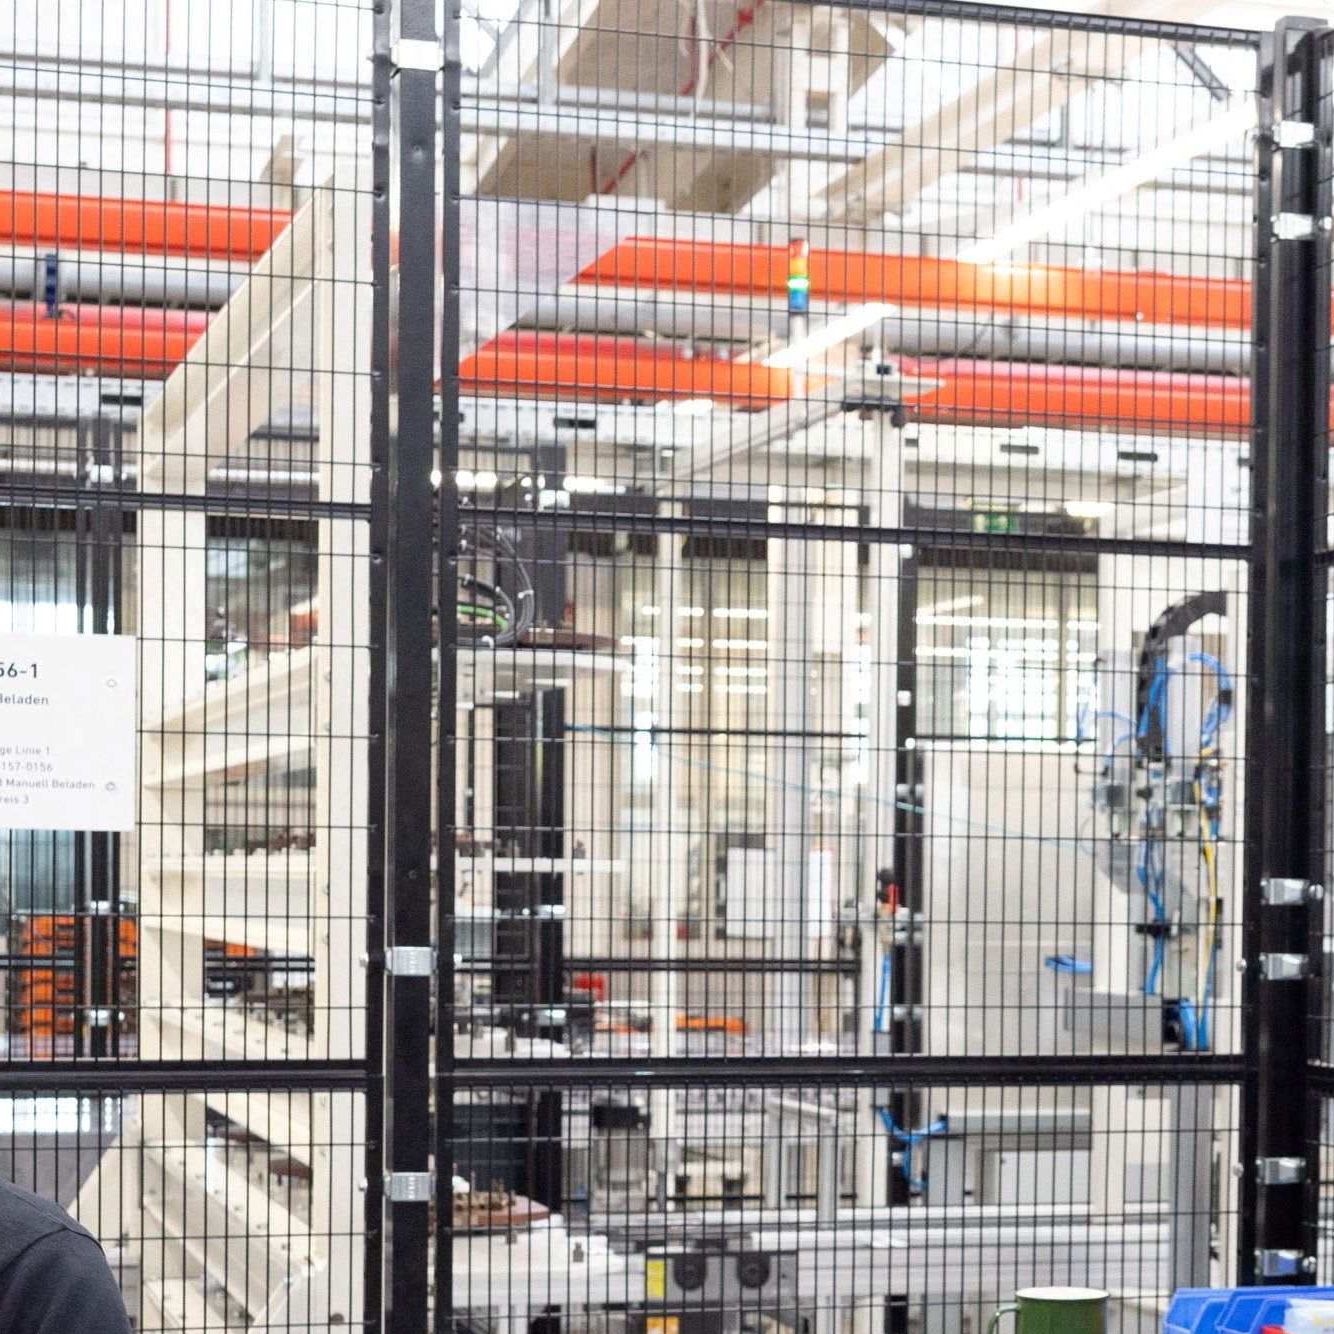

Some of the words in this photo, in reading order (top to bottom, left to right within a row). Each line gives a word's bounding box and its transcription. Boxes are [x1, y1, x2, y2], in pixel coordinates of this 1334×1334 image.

[15, 745, 42, 756] Linie
[5, 779, 49, 789] Manuell
[52, 779, 95, 789] Beladen
[22, 794, 30, 804] 3
